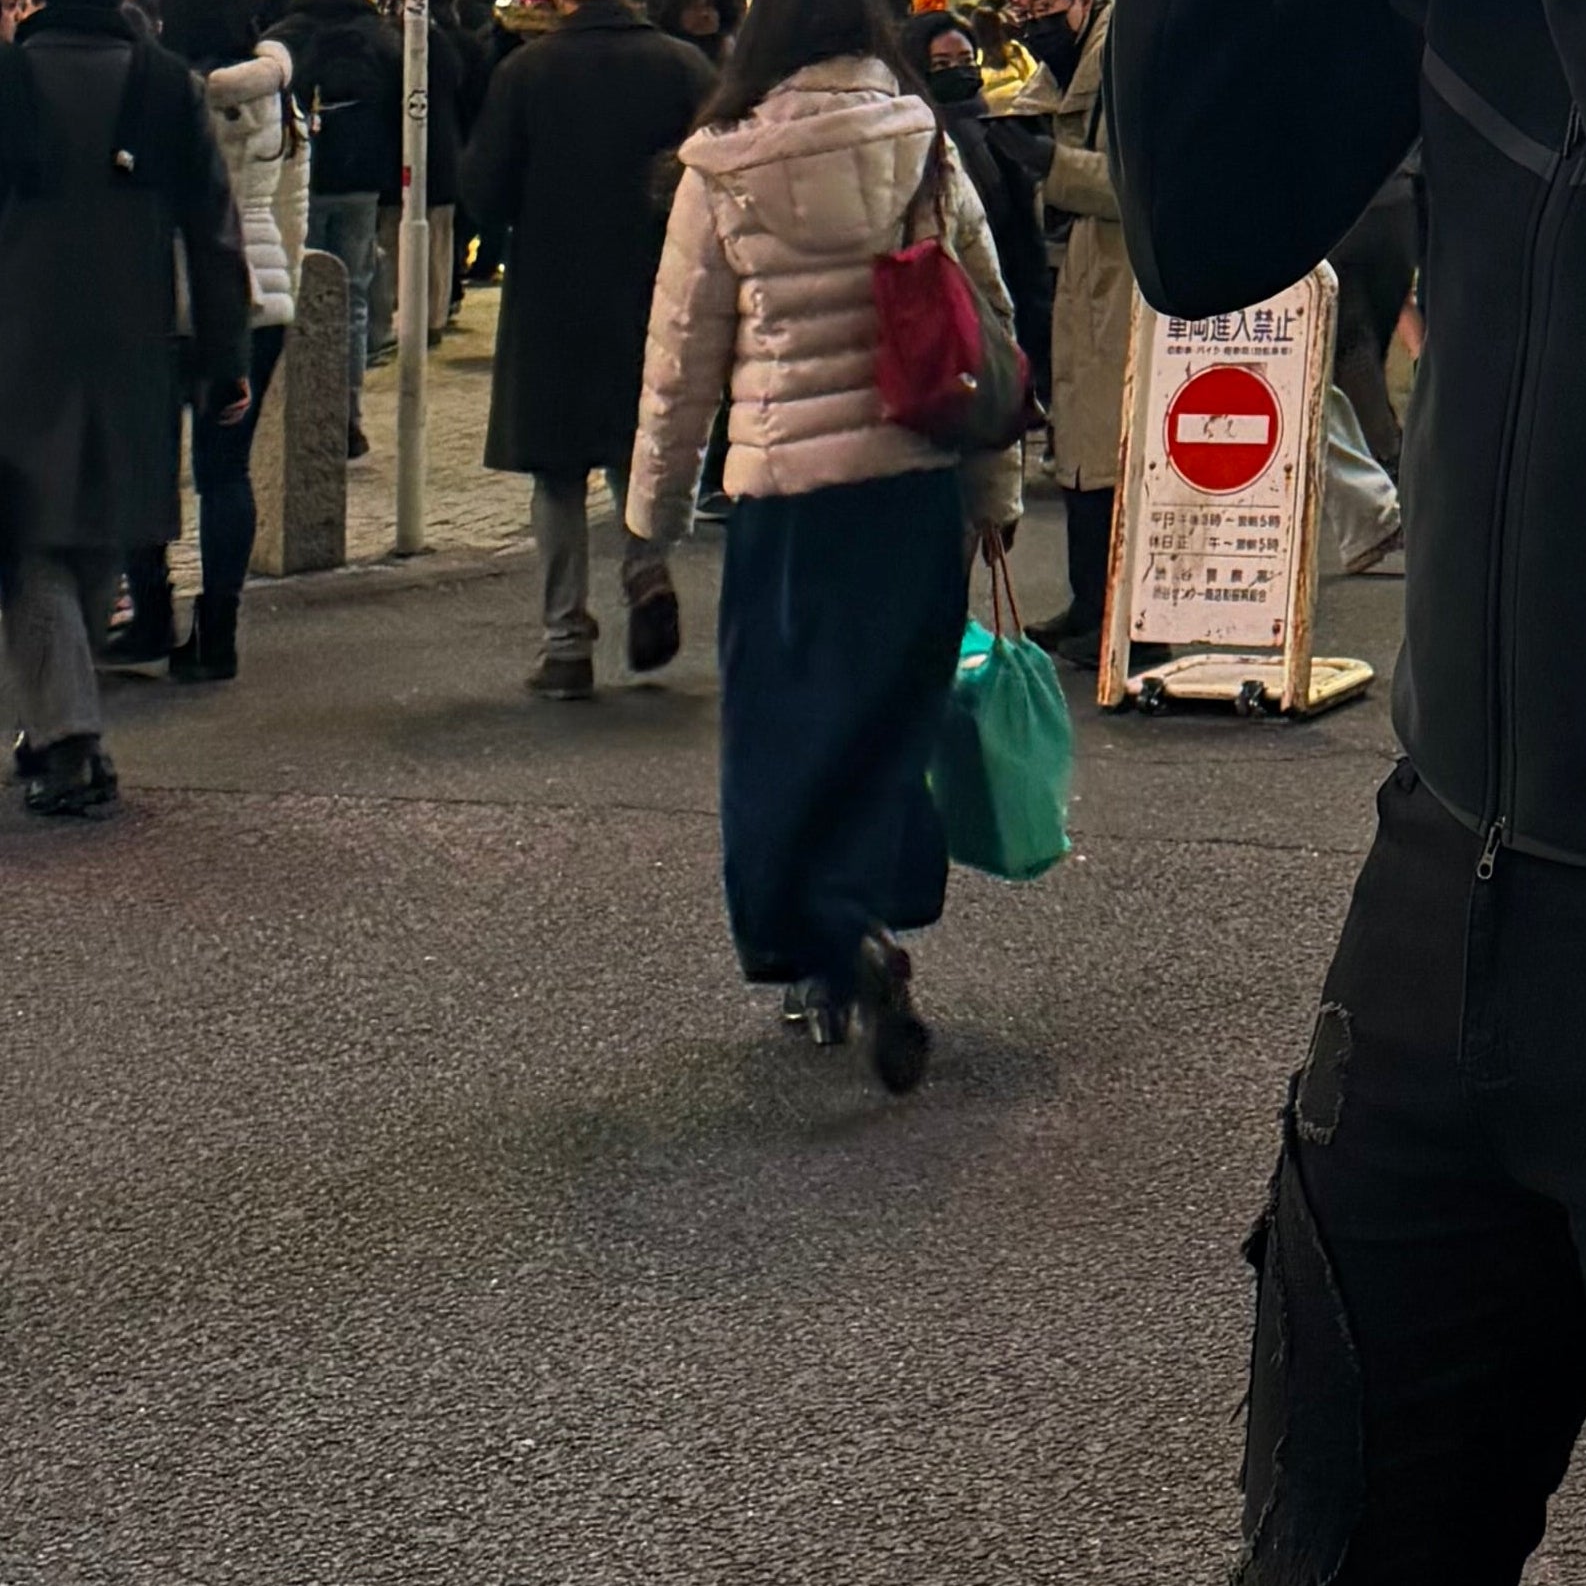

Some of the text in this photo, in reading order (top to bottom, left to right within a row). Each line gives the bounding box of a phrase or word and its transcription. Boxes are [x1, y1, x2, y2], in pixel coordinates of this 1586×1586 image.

[1167, 308, 1297, 343] 車両進入禁止
